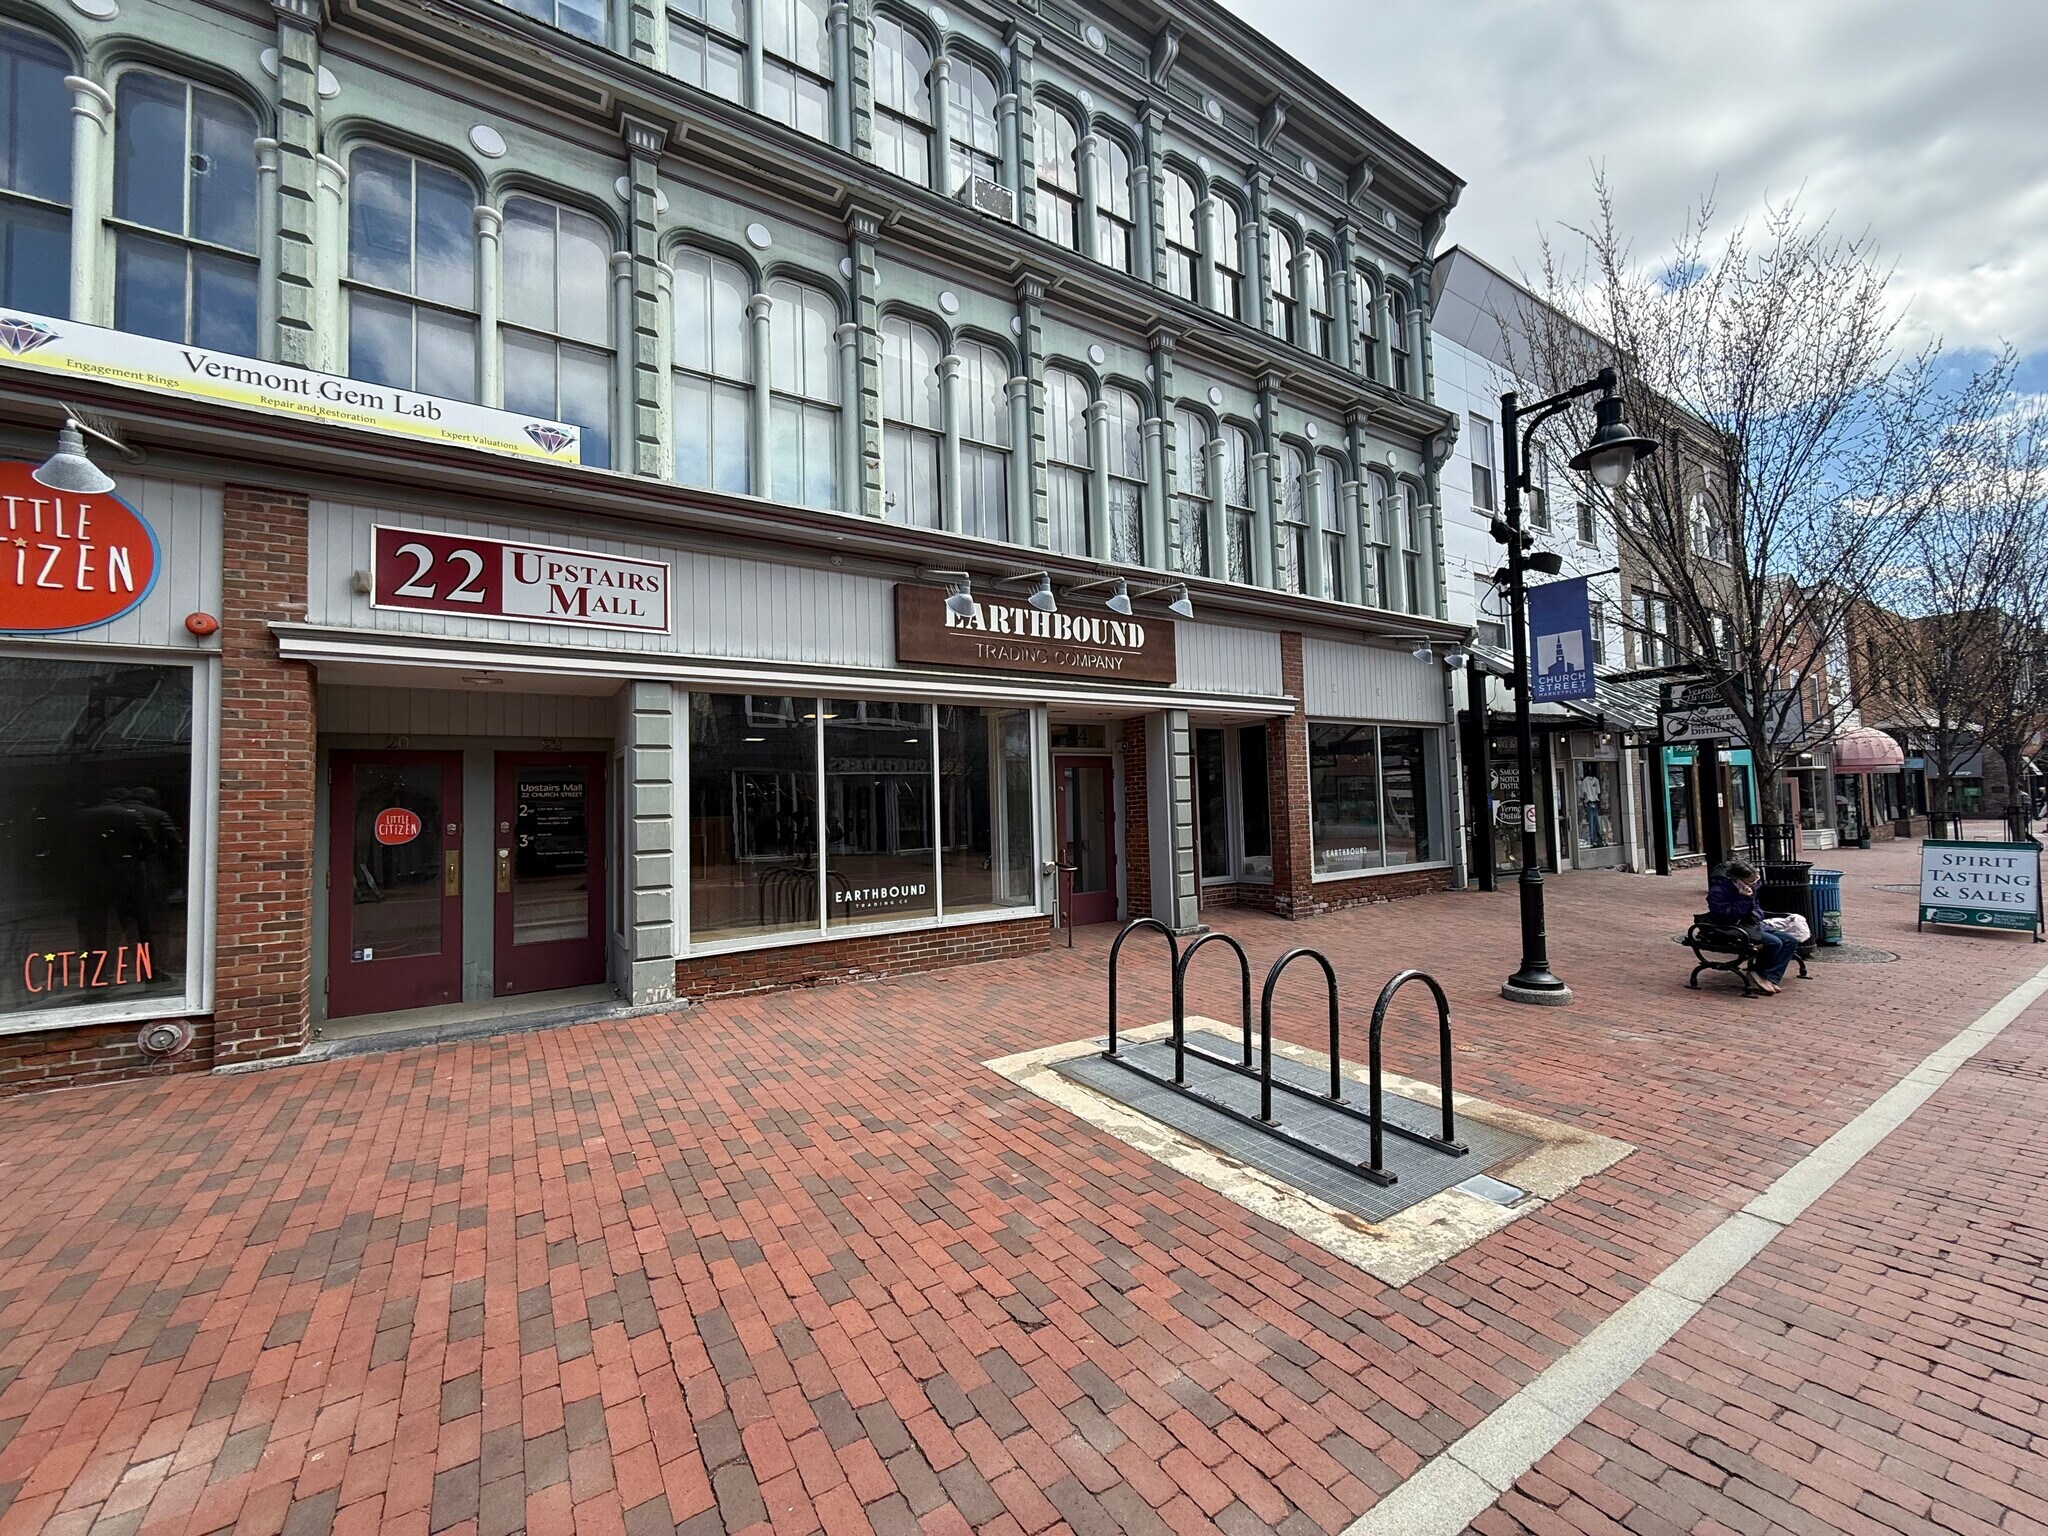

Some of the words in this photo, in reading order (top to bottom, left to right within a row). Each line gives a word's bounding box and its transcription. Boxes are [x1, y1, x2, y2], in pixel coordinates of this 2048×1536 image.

[66, 358, 144, 381] Engagement
[147, 373, 180, 388] Rings
[180, 351, 310, 396] Vermont
[320, 381, 384, 410] Gem
[393, 394, 442, 421] Lab
[260, 395, 295, 409] Repair
[297, 403, 316, 414] and
[319, 405, 376, 425] Restoration
[441, 429, 470, 442] Expert
[472, 435, 519, 450] Valuations
[393, 542, 488, 604] 22
[510, 551, 659, 593] UPSTAIRS
[546, 583, 645, 617] MALL
[975, 642, 1048, 664] TRADING
[1054, 651, 1123, 671] COMPANY
[1538, 672, 1586, 684] CHURCH
[1538, 680, 1586, 693] STREET
[1538, 688, 1587, 697] MARKETPLACE
[386, 735, 409, 749] 20
[521, 784, 560, 792] Upstairs
[563, 784, 583, 792] Mall
[519, 804, 535, 817] 2nd
[519, 834, 534, 847] 3rd
[1326, 846, 1368, 857] EARTHBOUND
[1942, 853, 2018, 868] SPIRIT
[1928, 869, 2030, 886] TASTING
[835, 884, 926, 903] EARTHBOUND
[1933, 886, 1951, 898] &
[1958, 887, 2026, 903] SALES
[855, 901, 895, 909] TRADING
